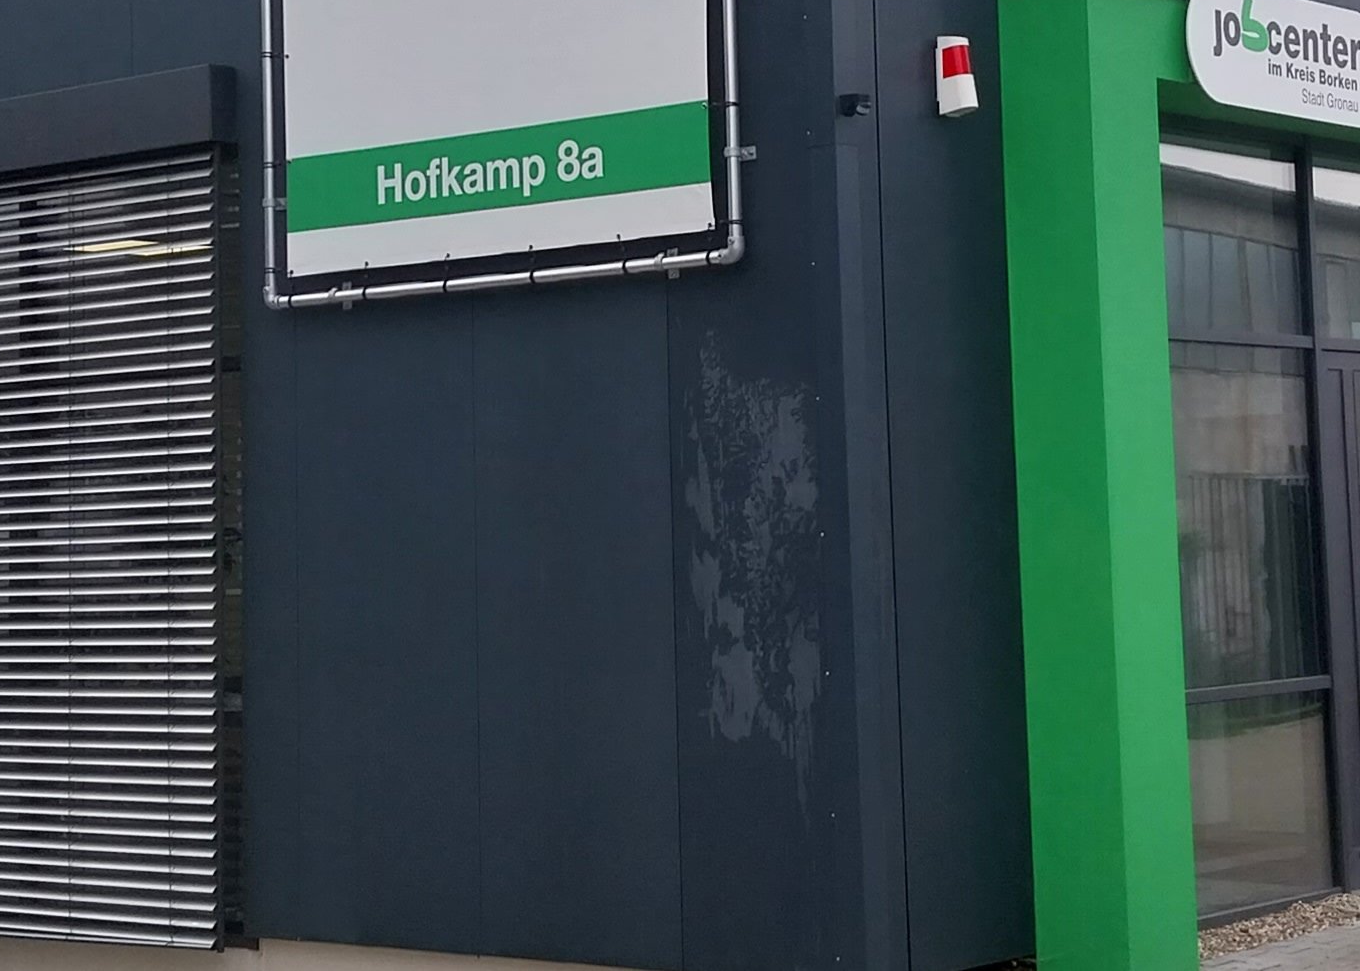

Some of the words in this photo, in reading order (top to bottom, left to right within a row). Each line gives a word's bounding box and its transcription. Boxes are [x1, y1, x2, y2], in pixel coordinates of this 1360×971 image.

[1268, 58, 1282, 77] im
[1286, 62, 1316, 84] Kreis
[1319, 69, 1358, 91] Borken
[1301, 88, 1325, 107] Stadt
[1327, 93, 1359, 113] Gronau
[377, 154, 546, 205] Hofkamp
[557, 139, 604, 182] 8a
